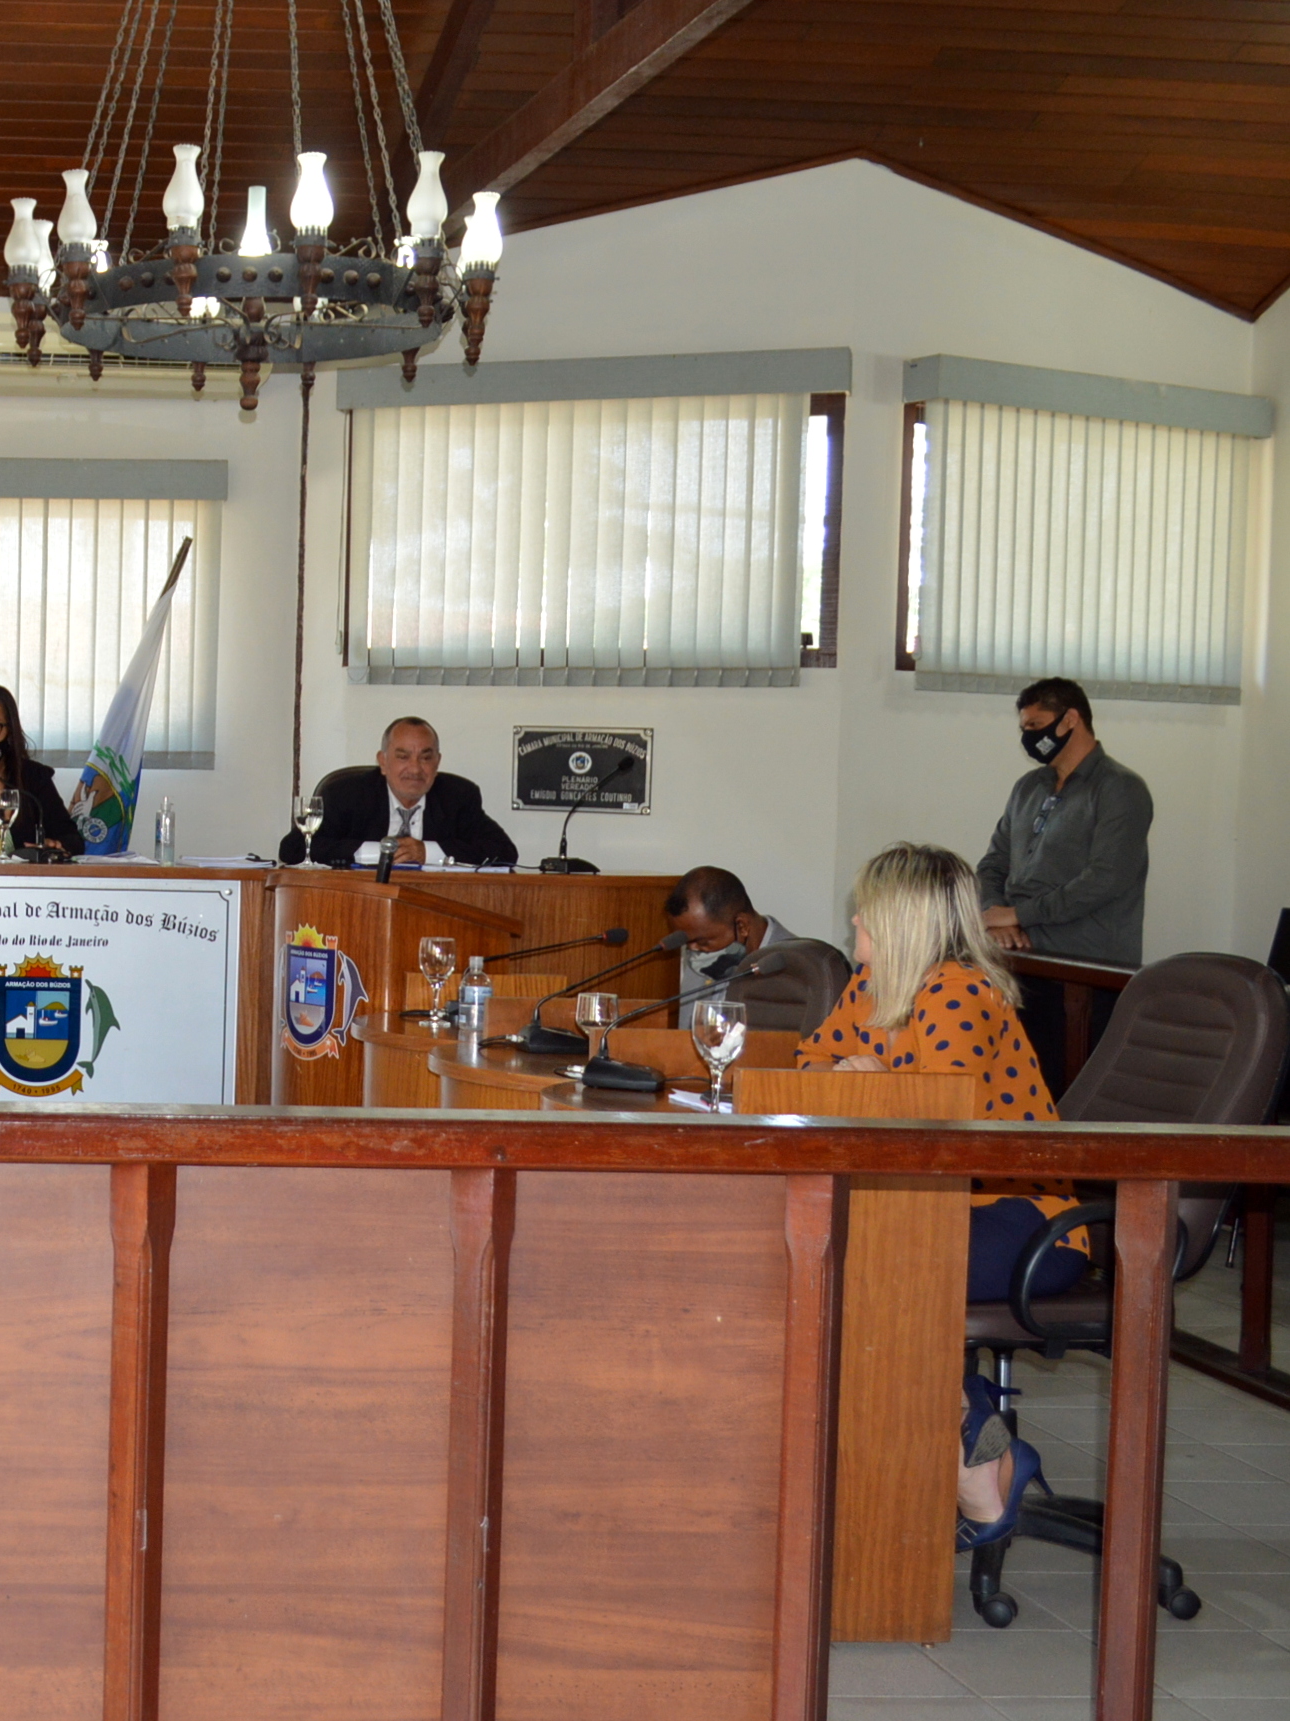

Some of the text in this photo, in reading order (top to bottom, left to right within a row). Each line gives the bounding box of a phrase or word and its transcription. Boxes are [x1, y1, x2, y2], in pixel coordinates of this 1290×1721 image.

[562, 775, 598, 783] PLENÁRIO
[600, 792, 632, 802] COUTINHO
[25, 902, 43, 919] de
[46, 900, 120, 927] Armação
[125, 908, 155, 928] dos
[159, 911, 220, 943] Búzios
[11, 934, 26, 946] do
[65, 935, 110, 948] Janeiro
[5, 980, 35, 989] ARMAÇÃO
[49, 981, 71, 989] BÚZIOS
[12, 1083, 61, 1095] 1740 1995
